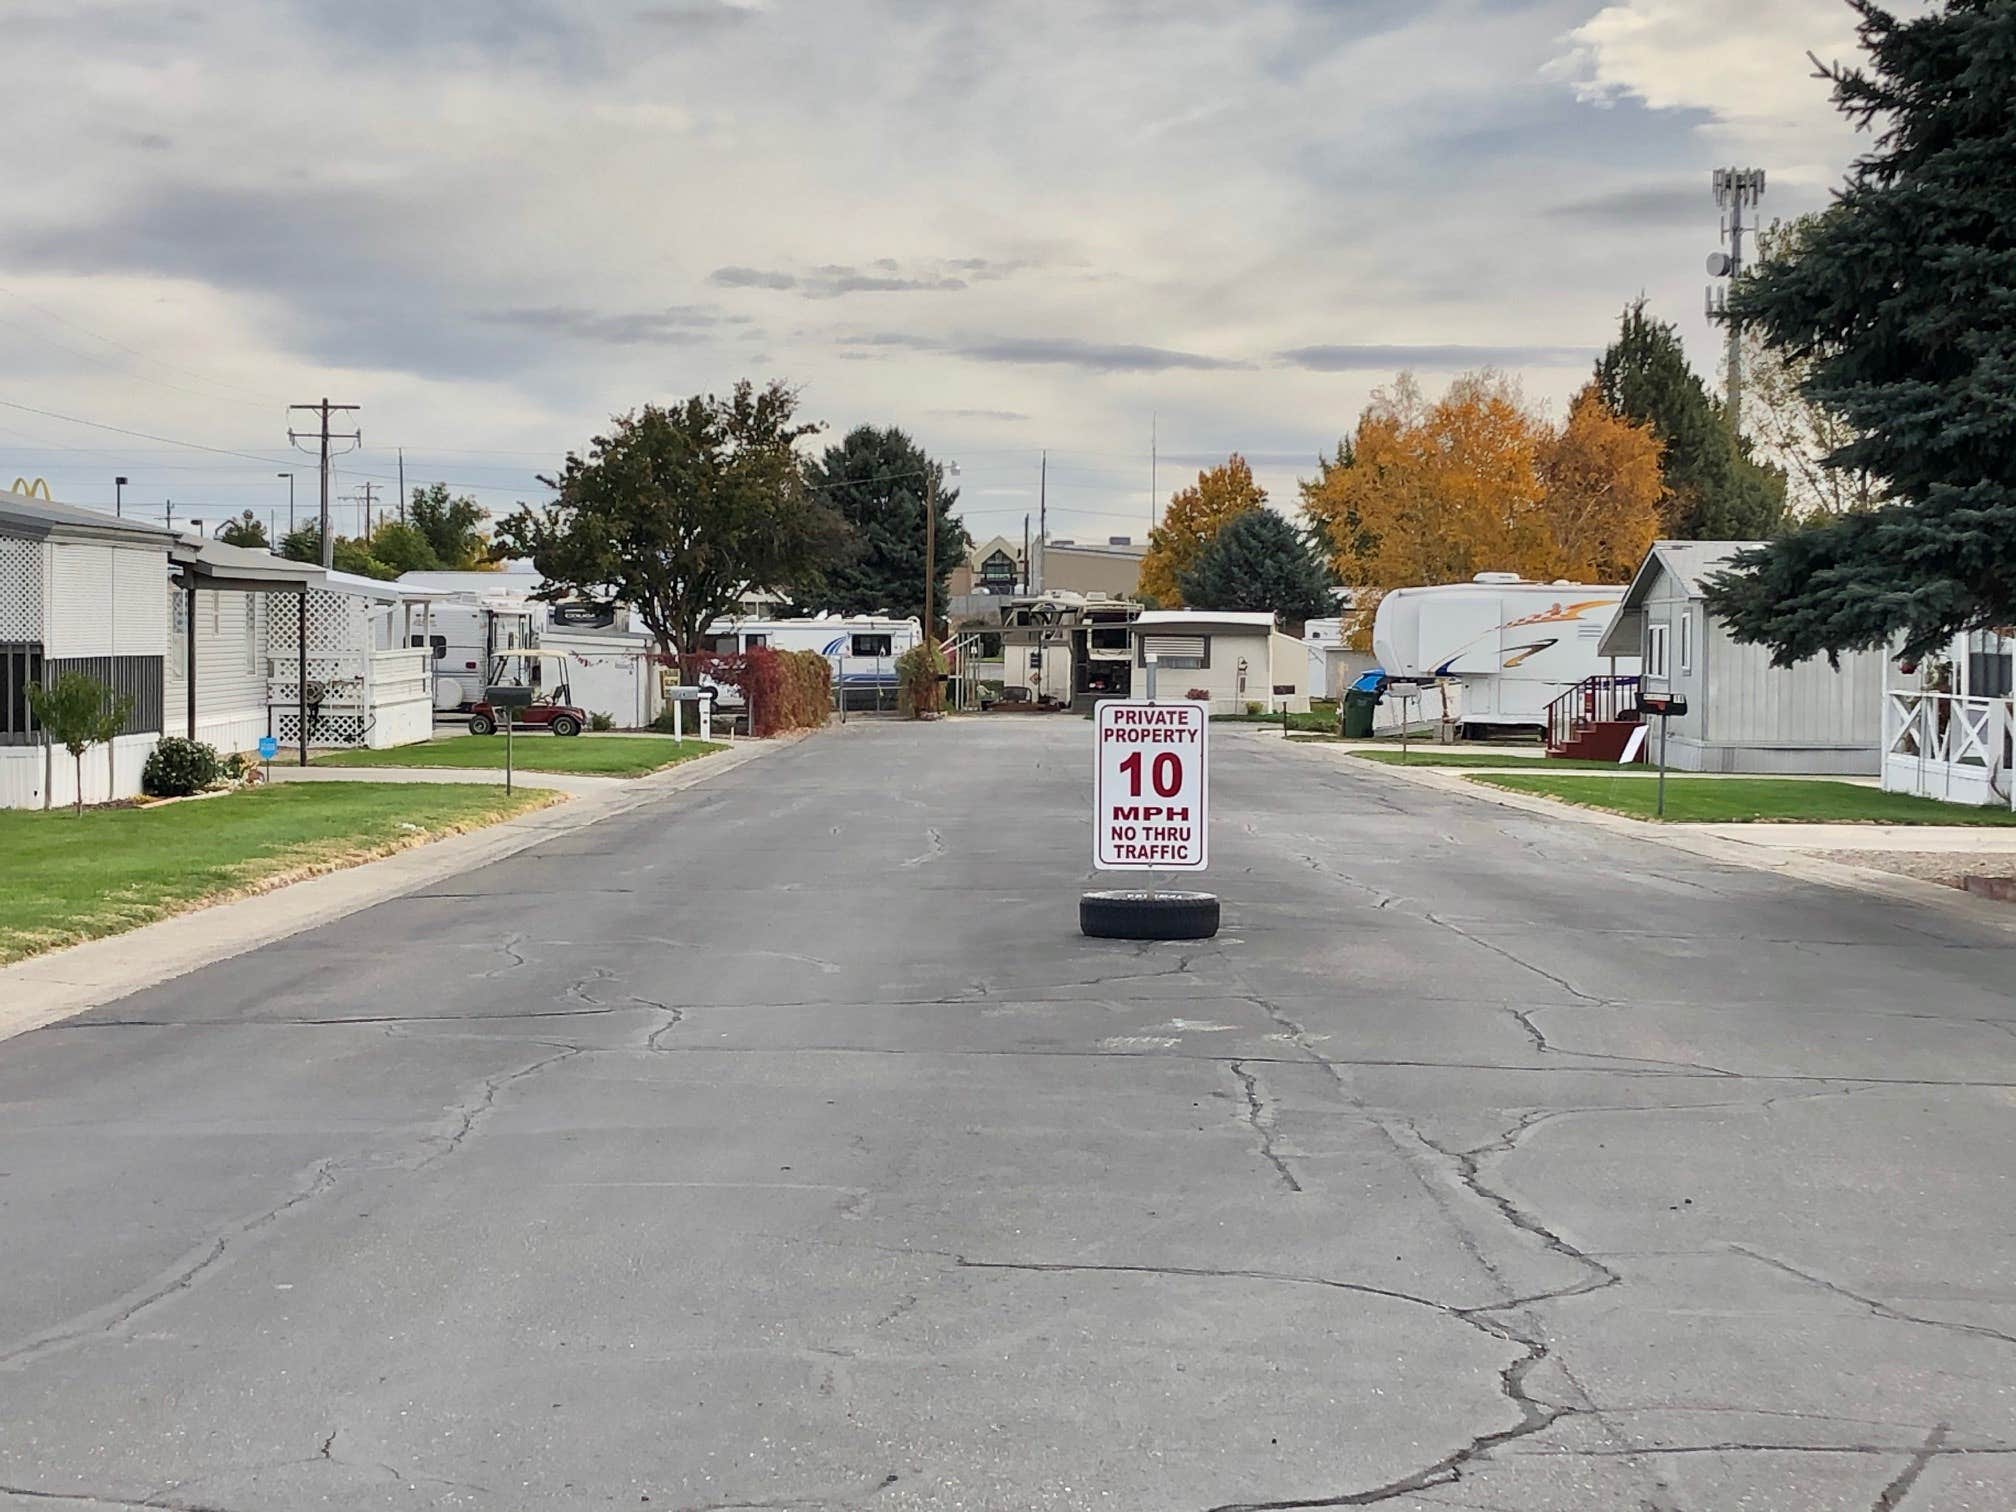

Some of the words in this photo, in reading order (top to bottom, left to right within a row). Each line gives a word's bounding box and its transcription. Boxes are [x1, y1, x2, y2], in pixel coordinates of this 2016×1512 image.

[1114, 710, 1188, 725] PRIVATE
[1104, 728, 1198, 743] PROPERTY
[1120, 752, 1183, 797] 10
[1113, 806, 1188, 821] MPH
[1112, 826, 1136, 840] NO
[1142, 827, 1191, 841] THRU
[1113, 844, 1188, 859] TRAFFIC
